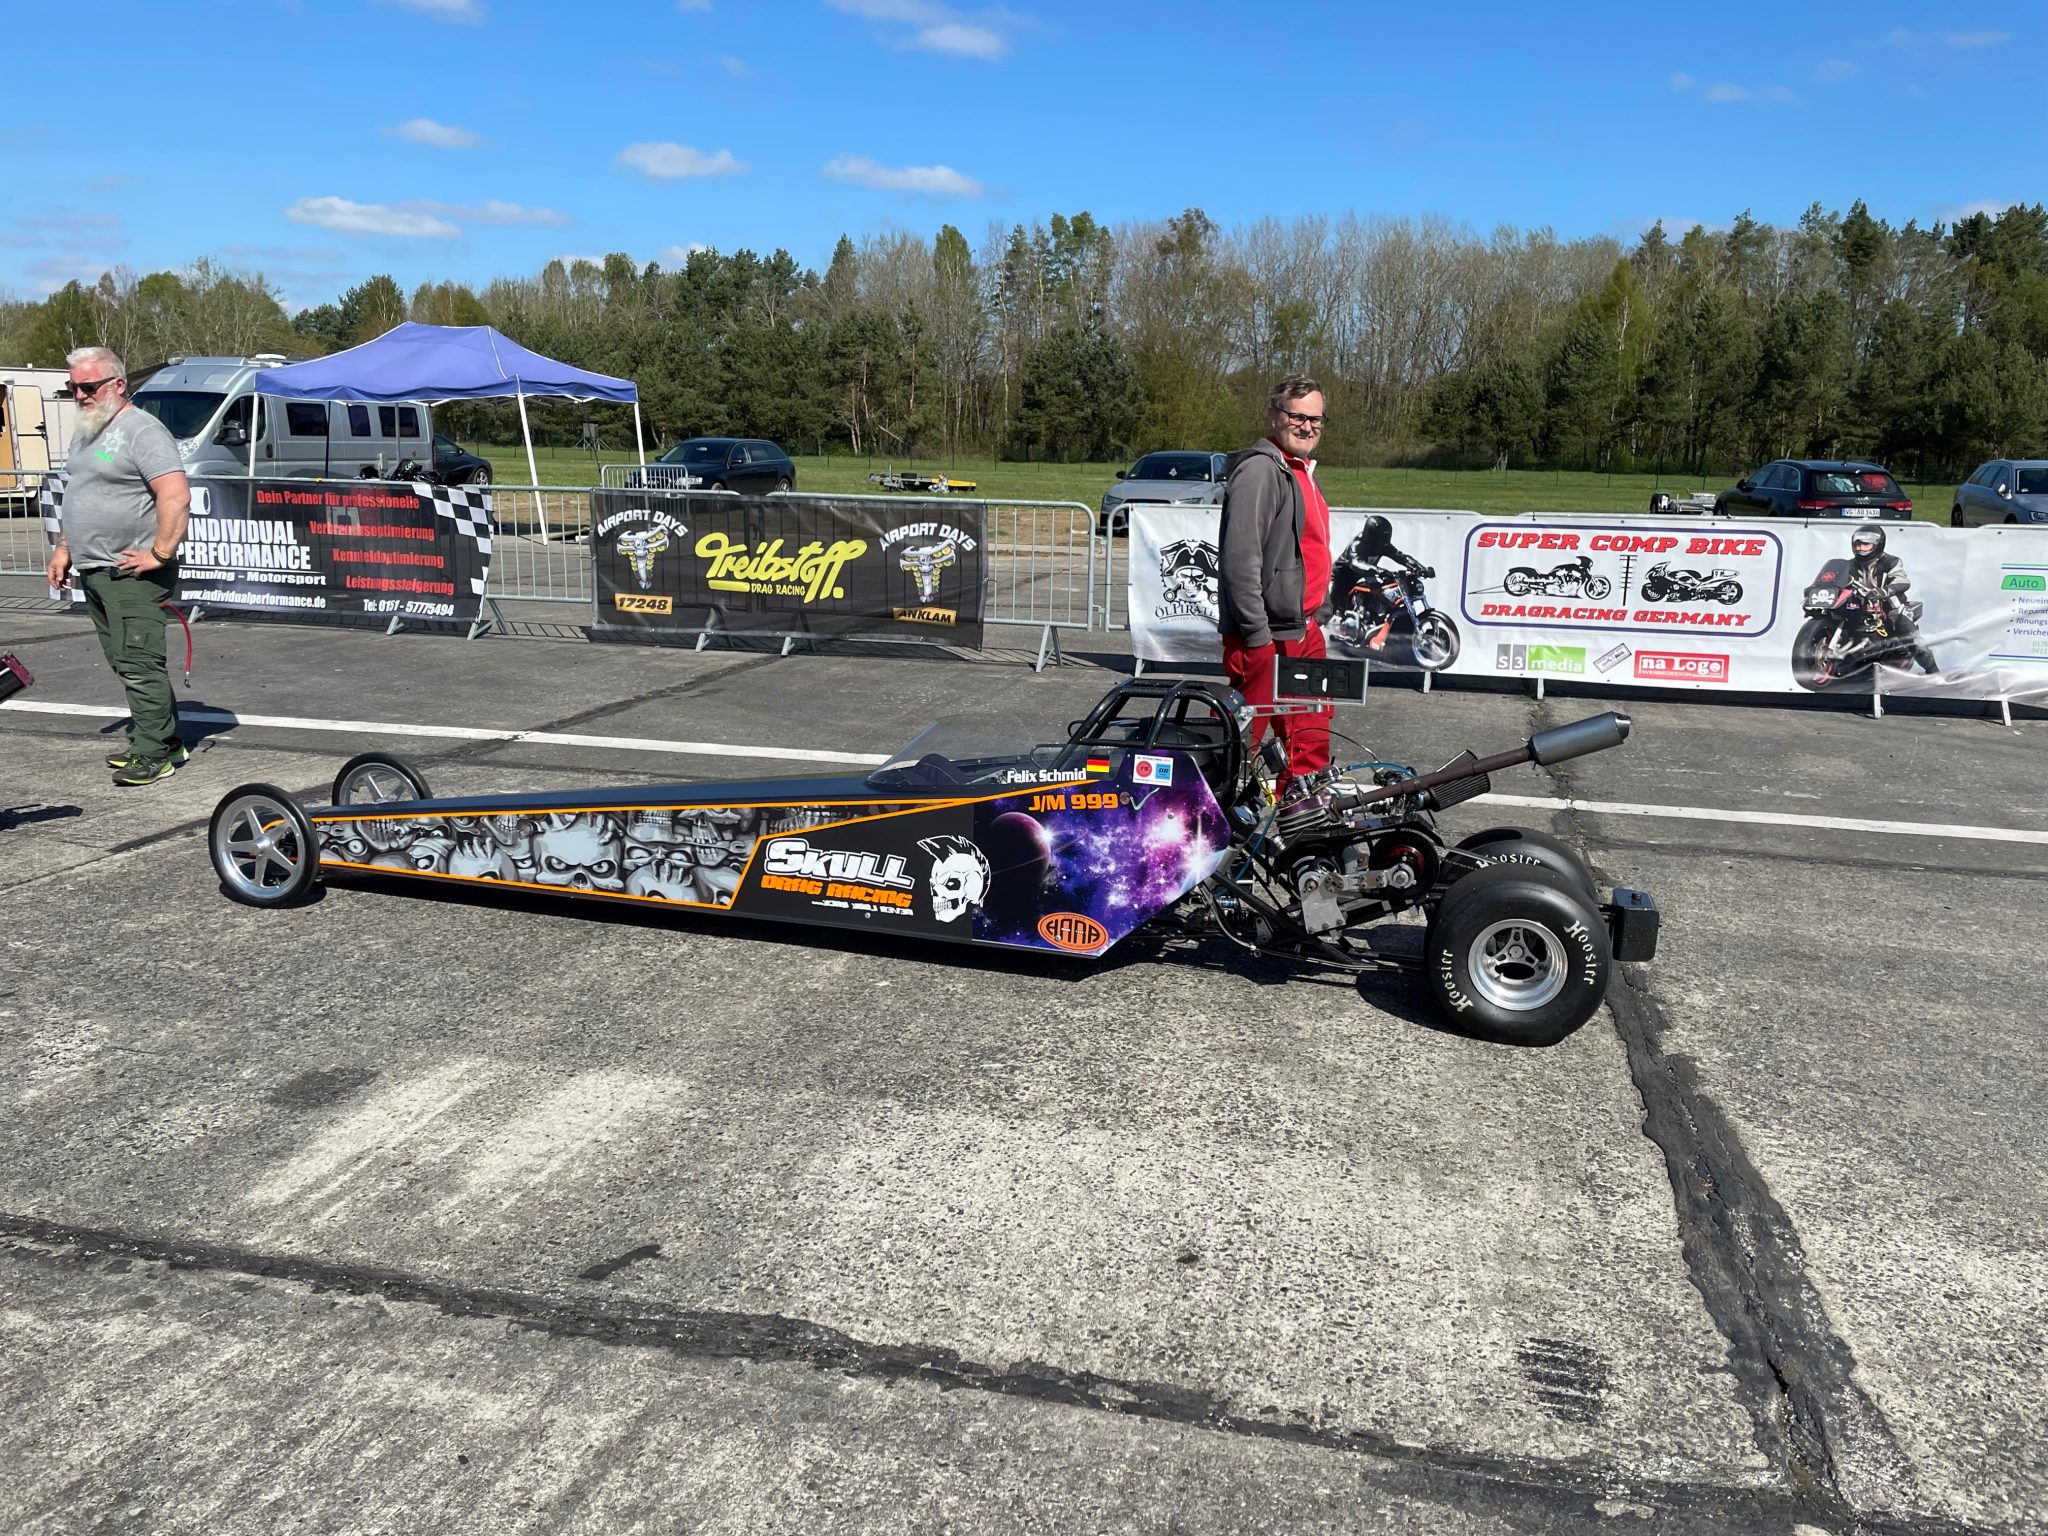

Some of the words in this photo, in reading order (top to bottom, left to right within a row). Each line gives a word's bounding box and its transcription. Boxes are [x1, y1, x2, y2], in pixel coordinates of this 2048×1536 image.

[256, 490, 283, 504] Dein
[284, 491, 323, 505] Partner
[325, 492, 340, 506] für
[342, 494, 420, 509] professionelle
[187, 518, 297, 545] INDIVIDUAL
[597, 510, 651, 537] AIRPORT
[653, 511, 688, 537] DAYS
[879, 523, 938, 552] AIRPORT
[939, 524, 977, 551] DAYS
[1477, 531, 1581, 551] SUPER
[1589, 535, 1678, 554] COMP
[1685, 539, 1767, 556] BIKE
[176, 541, 311, 570] PERFORMANCE
[333, 548, 444, 568] Kennfeldoptimierung
[178, 568, 235, 581] iptuning
[247, 572, 326, 585] Motorsport
[346, 575, 454, 595] Leistungssteigerung
[2009, 578, 2039, 588] Auto
[181, 589, 326, 608] www.individualperformance.de
[751, 584, 773, 595] DRAG
[776, 585, 806, 596] RACING
[618, 597, 668, 610] 17248
[898, 610, 951, 623] ANKLAM
[1480, 604, 1627, 621] DRAGRACING
[1633, 610, 1751, 627] GERMANY
[2013, 628, 2048, 636] Versiche
[1531, 656, 1583, 673] media
[1642, 658, 1666, 670] na
[1007, 768, 1037, 783] Felix
[1039, 768, 1087, 782] Schmid
[1071, 793, 1119, 810] 999
[764, 838, 915, 890] SKULL
[761, 874, 823, 895] DRAG
[826, 883, 913, 908] RACING
